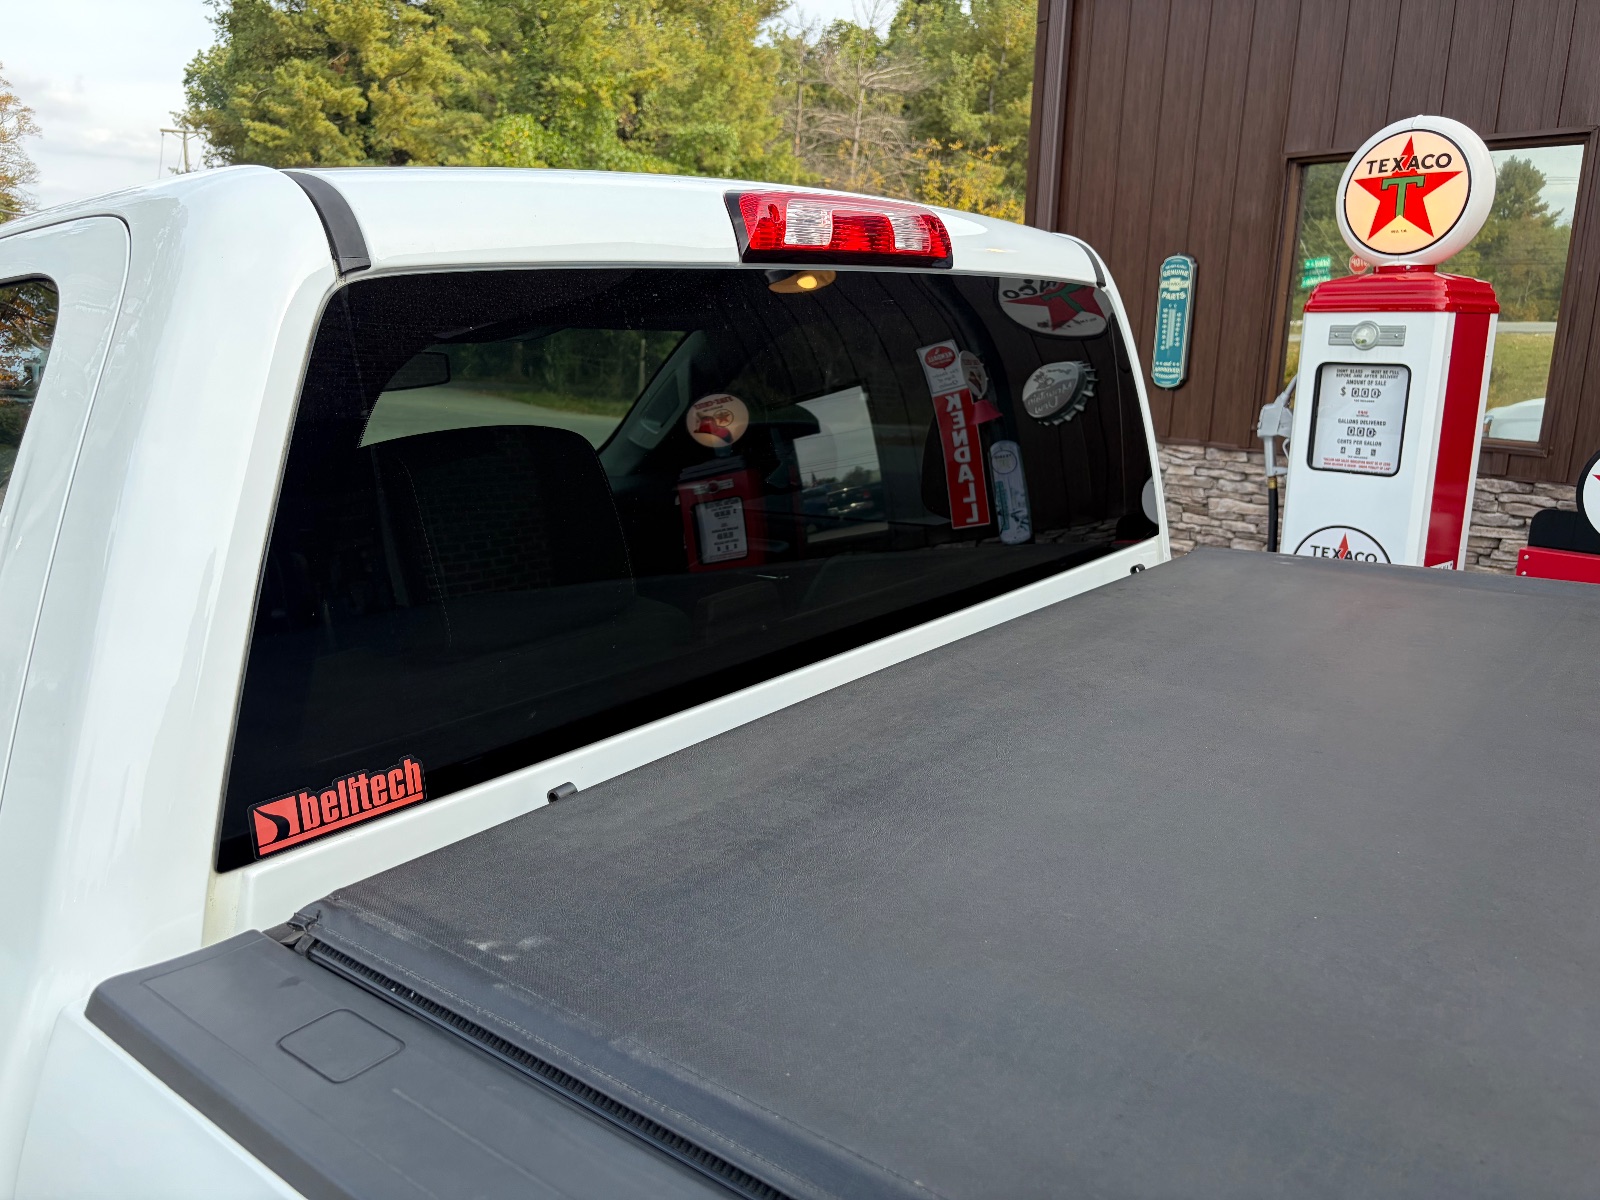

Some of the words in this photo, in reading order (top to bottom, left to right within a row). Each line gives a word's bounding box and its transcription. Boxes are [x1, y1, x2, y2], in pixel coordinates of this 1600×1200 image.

[1366, 152, 1453, 175] TEXACO
[1161, 291, 1186, 300] PARTS
[1310, 545, 1378, 563] TEXACO
[299, 758, 423, 832] belltech
